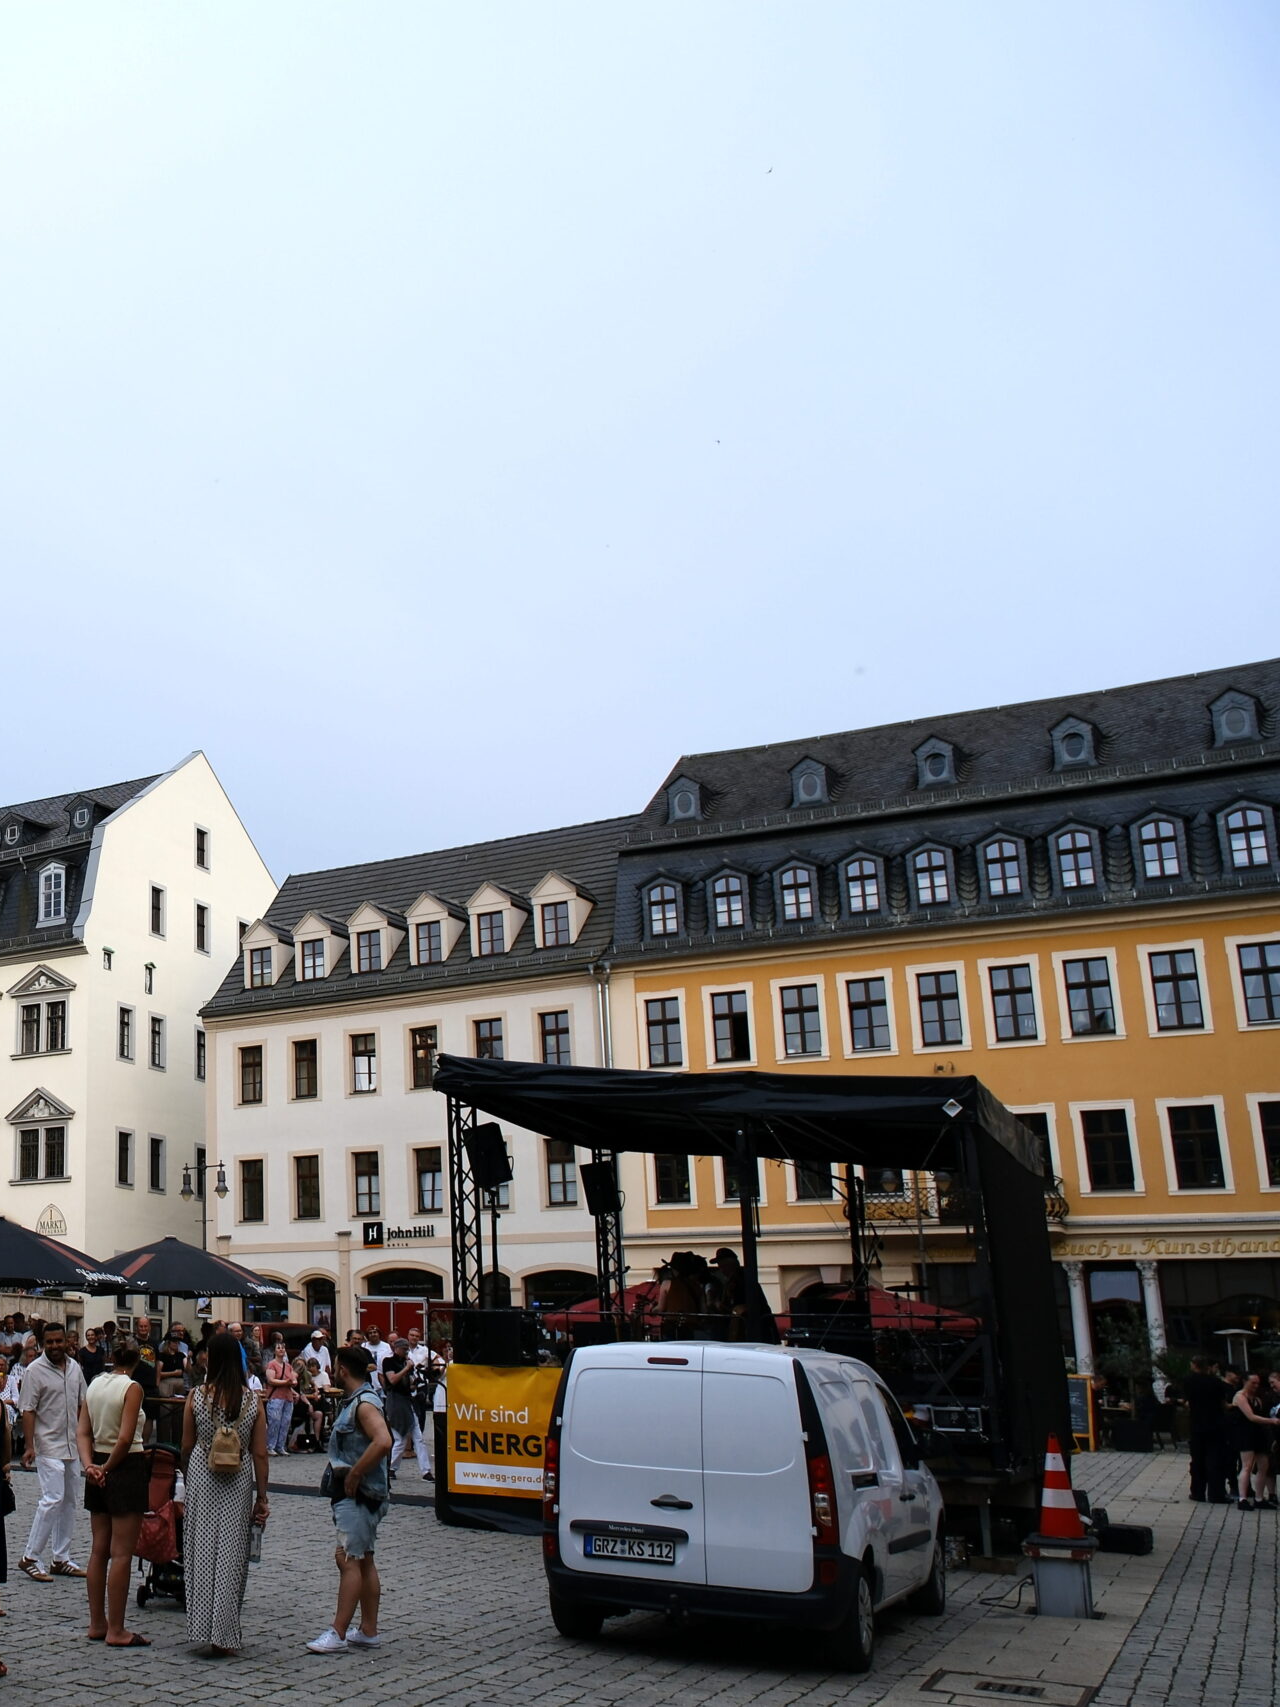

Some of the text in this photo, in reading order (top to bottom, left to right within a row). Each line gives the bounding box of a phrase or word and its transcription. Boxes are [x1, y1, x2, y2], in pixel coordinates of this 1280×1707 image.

[39, 1220, 63, 1230] MARKT
[454, 1403, 528, 1424] Wir sind
[455, 1430, 542, 1457] ENERG
[463, 1470, 543, 1484] www.egg-gera.d
[593, 1537, 618, 1554] GRZ
[627, 1540, 645, 1556] KS
[648, 1542, 673, 1559] 112
